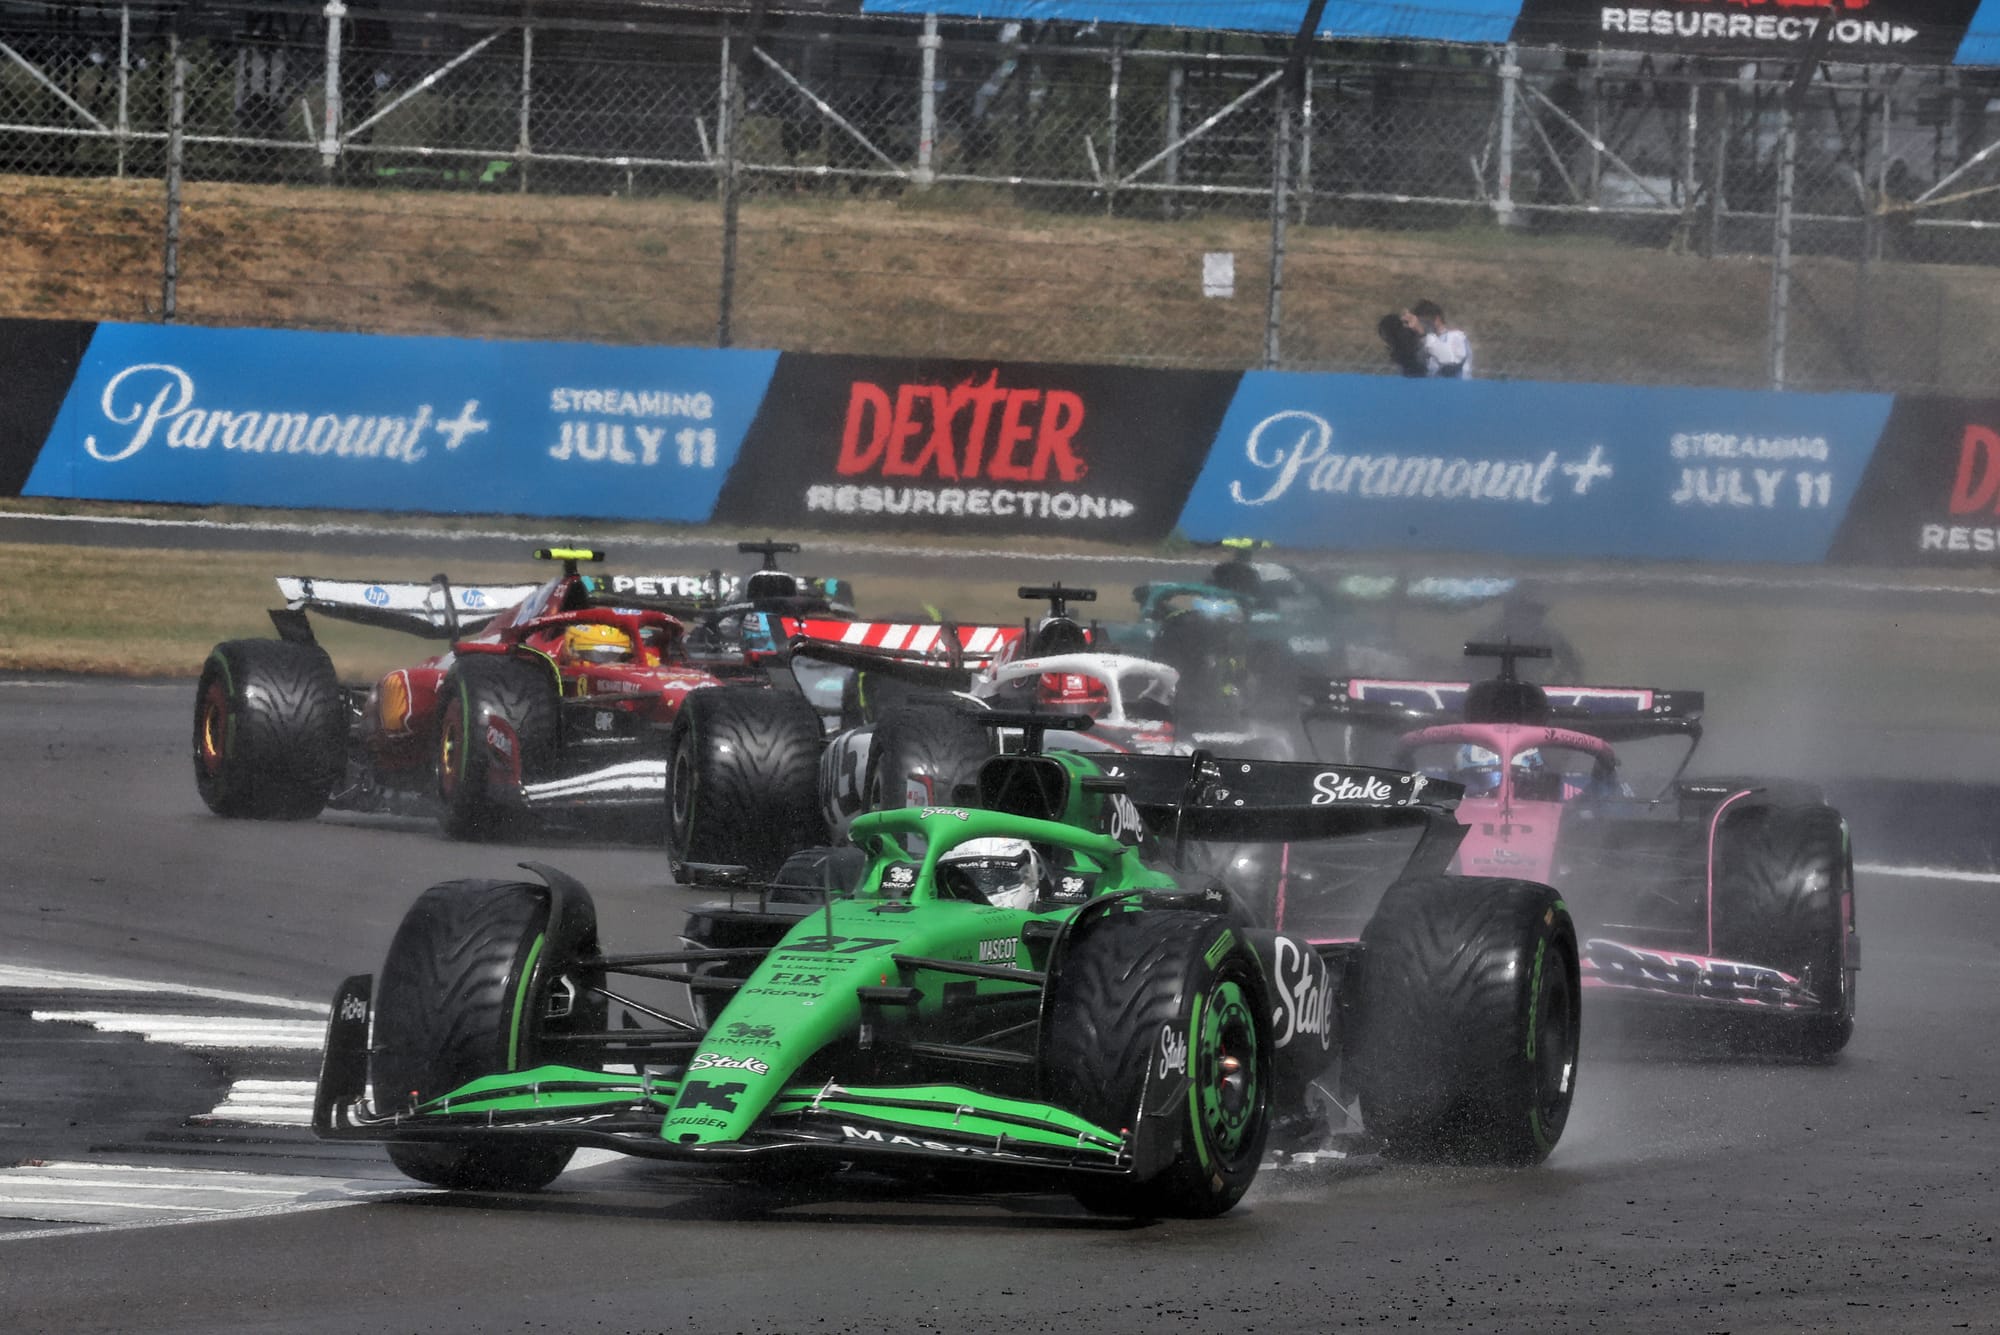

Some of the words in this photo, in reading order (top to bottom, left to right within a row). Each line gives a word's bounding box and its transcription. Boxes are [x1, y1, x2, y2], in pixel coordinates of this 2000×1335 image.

[84, 363, 489, 463] Paramount+
[550, 388, 713, 419] STREAMING
[836, 368, 1088, 482] DEXTER
[549, 421, 663, 462] JULY
[676, 427, 716, 468] 11
[1229, 410, 1613, 505] Paramount+
[1670, 432, 1829, 461] STREAMING
[806, 484, 1107, 519] RESURRECTION
[1671, 467, 1778, 508] JULY
[1795, 471, 1832, 507] 11
[1921, 523, 2000, 551] RES
[1312, 773, 1392, 805] Stake
[920, 806, 970, 821] Stake
[780, 935, 901, 954] 27
[978, 937, 1018, 961] MASCOT
[771, 972, 827, 984] FIX
[1272, 936, 1333, 1052] Stake
[688, 1053, 770, 1076] Stake
[1160, 1025, 1187, 1080] Stake
[668, 1117, 728, 1130] SAUBER
